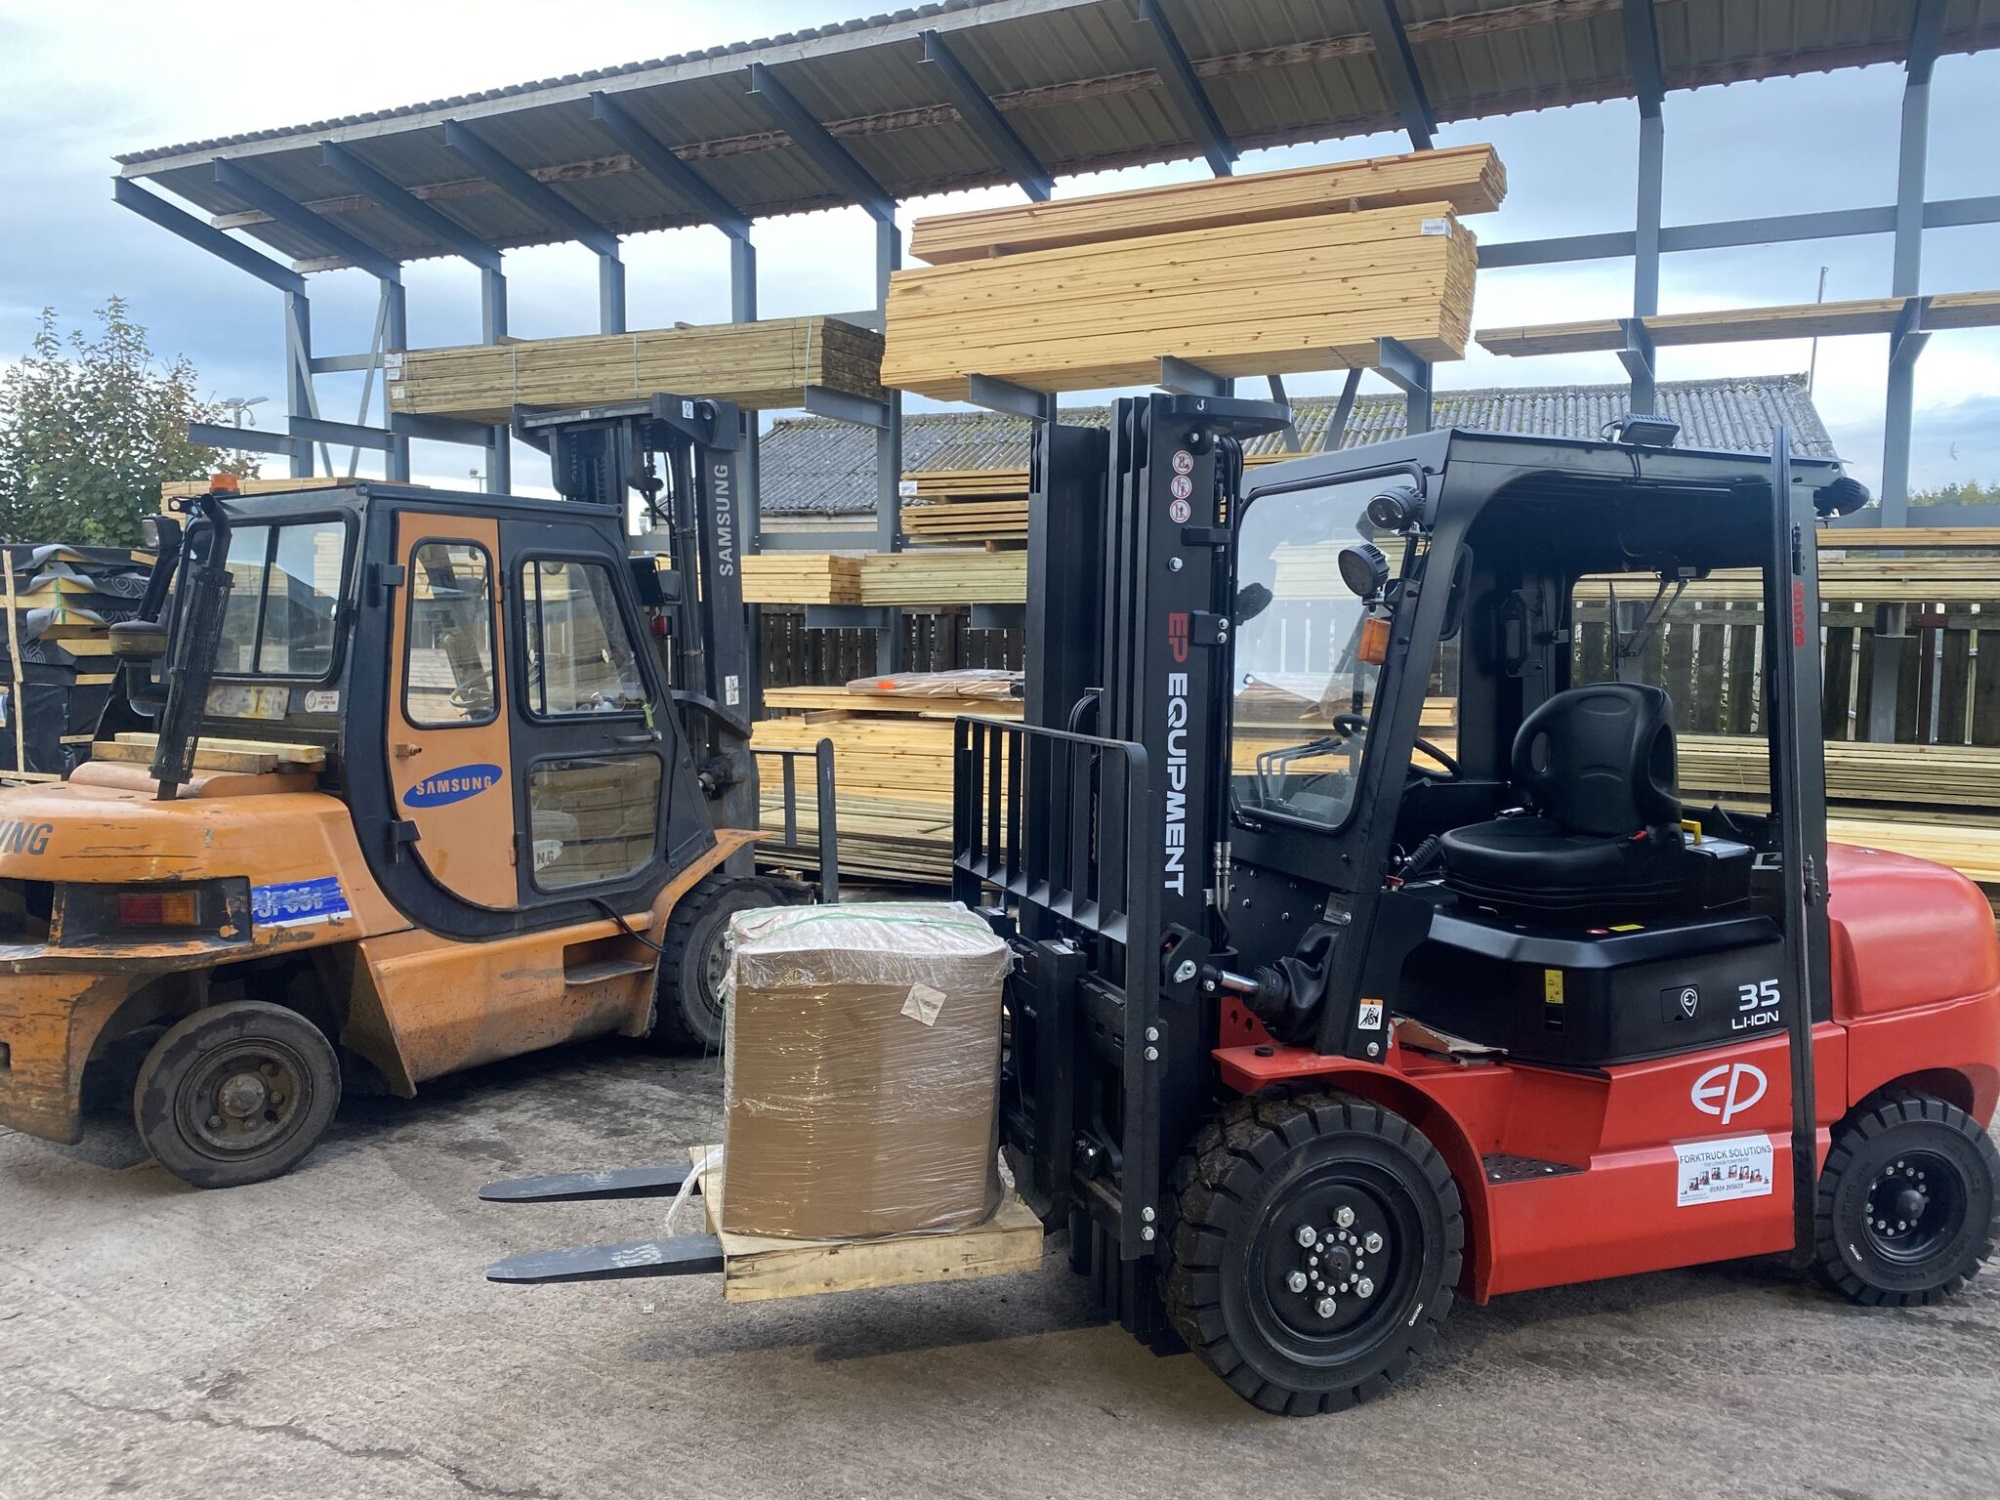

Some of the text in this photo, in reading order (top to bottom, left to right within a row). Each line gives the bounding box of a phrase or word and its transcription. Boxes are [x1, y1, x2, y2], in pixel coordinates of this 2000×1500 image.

[714, 464, 734, 576] SAMSUNG
[1164, 612, 1189, 897] EP EQUIPMENT
[415, 775, 492, 796] SAMSUNG
[1738, 979, 1781, 1011] 35
[1732, 1010, 1779, 1030] LI-ION
[1690, 1063, 1768, 1125] EP
[1680, 1150, 1728, 1164] FORKTRUCK
[1728, 1145, 1772, 1158] SOLUTIONS
